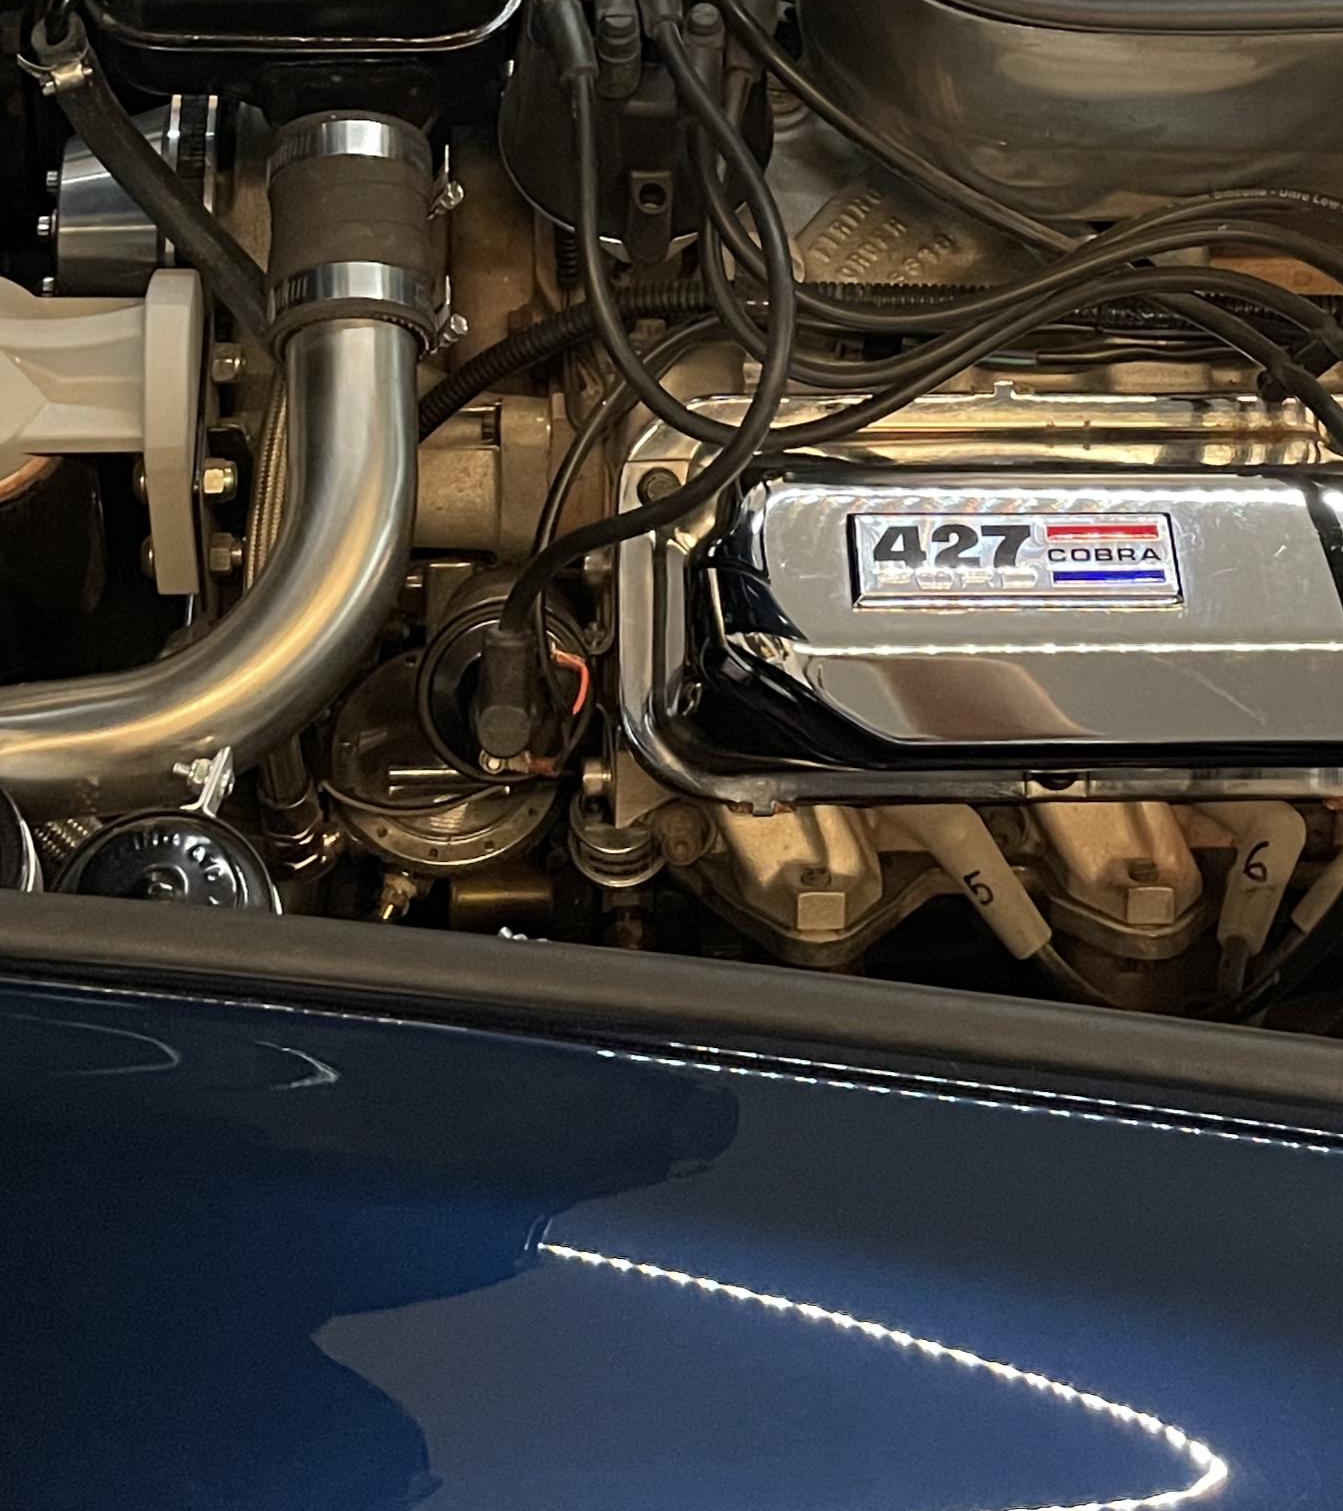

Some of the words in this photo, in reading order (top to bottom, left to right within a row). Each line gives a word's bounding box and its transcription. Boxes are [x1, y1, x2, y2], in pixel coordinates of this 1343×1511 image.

[1279, 188, 1310, 201] Ultra
[1312, 194, 1340, 210] Low
[808, 189, 882, 263] FIRING
[837, 218, 908, 284] ORDER
[872, 523, 1031, 569] 427
[1047, 547, 1162, 563] COBRA
[1242, 841, 1269, 883] 6
[962, 869, 994, 907] 5
